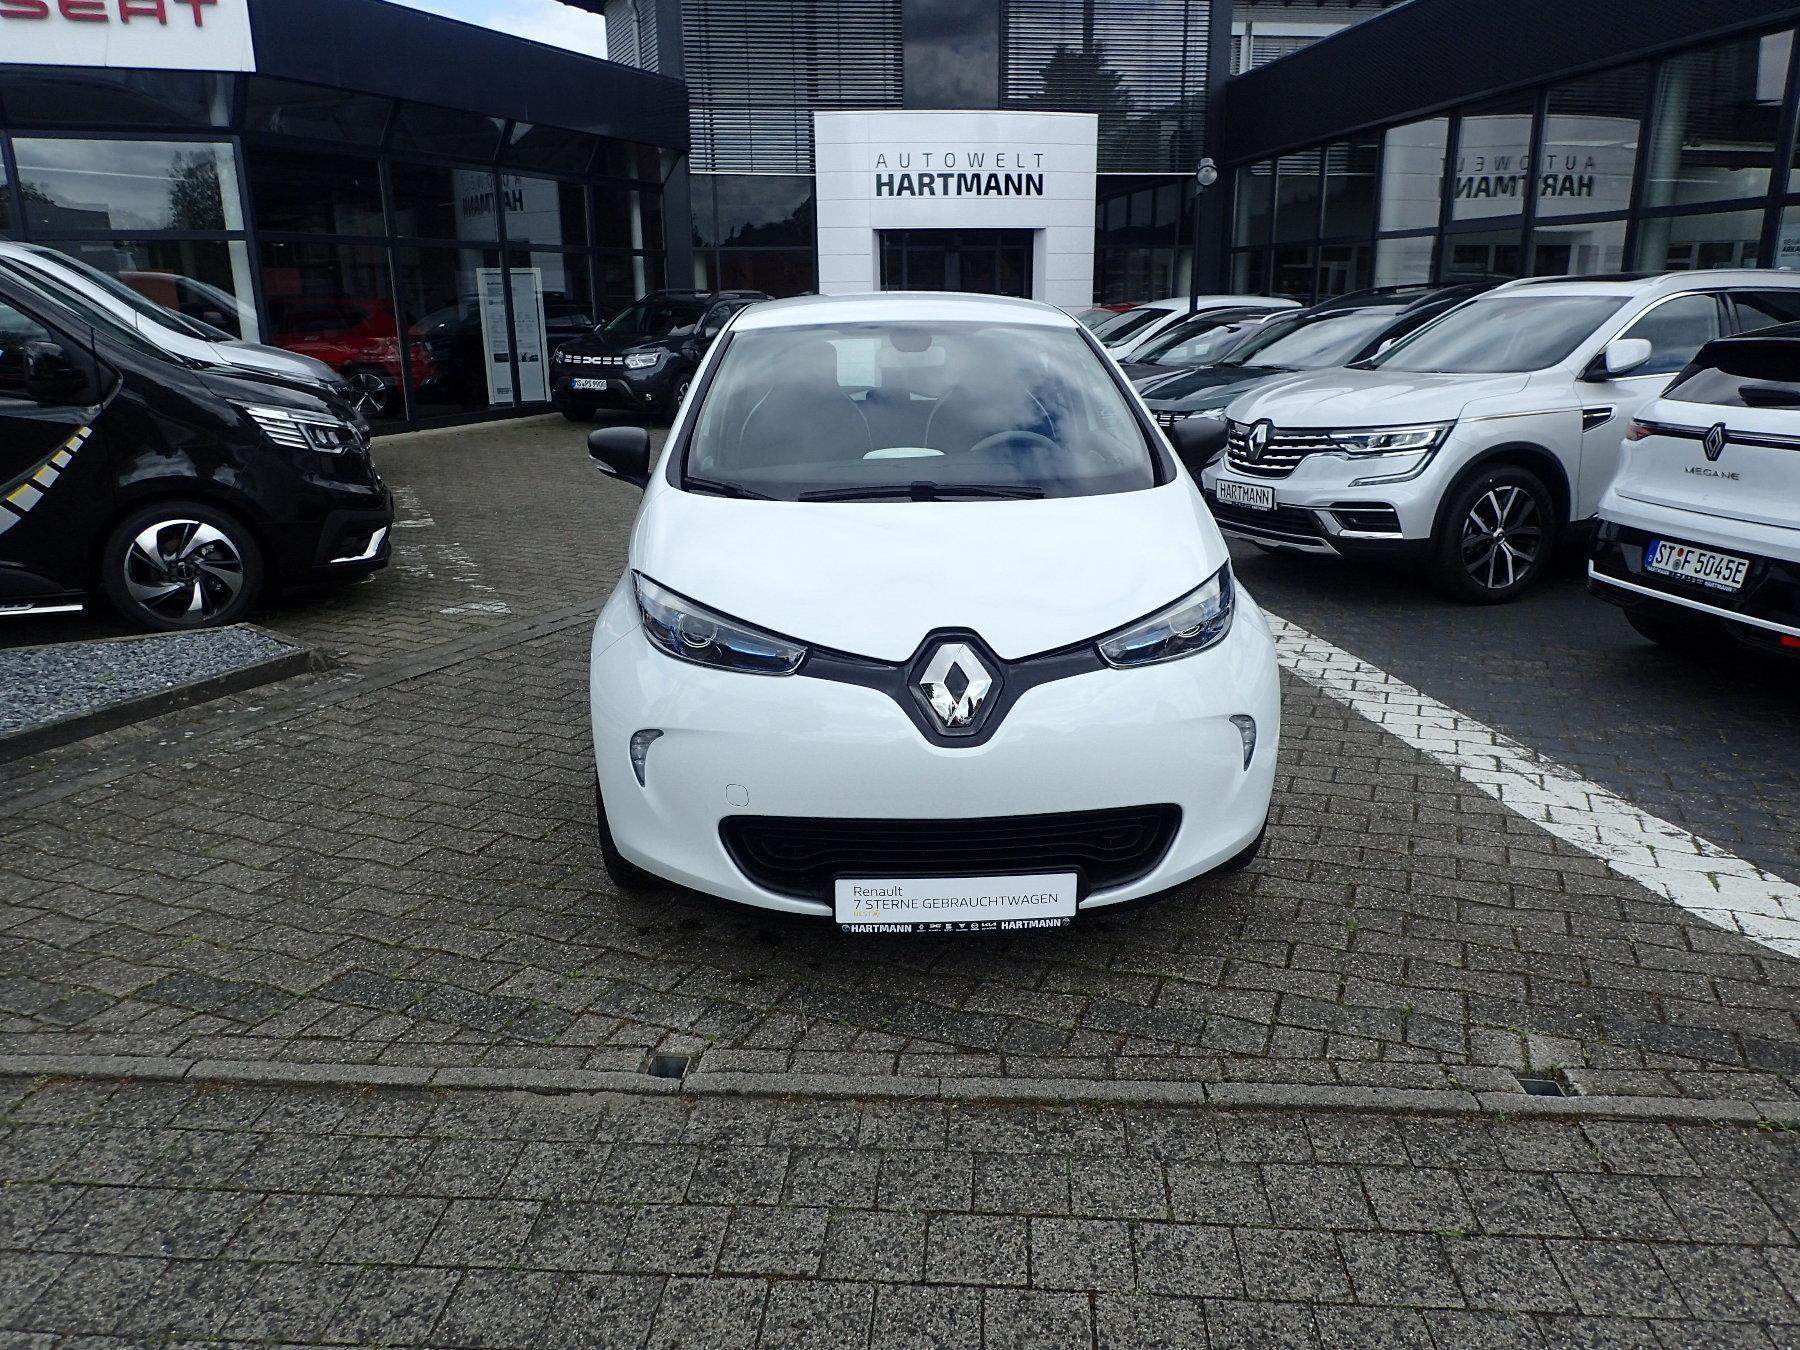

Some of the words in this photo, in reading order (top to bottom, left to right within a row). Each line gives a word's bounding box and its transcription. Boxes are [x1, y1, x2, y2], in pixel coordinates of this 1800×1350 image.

[0, 0, 218, 27] SEAT
[876, 152, 1044, 169] AUTOWELT
[876, 173, 1044, 197] HARTMANN
[1684, 466, 1741, 481] MEGANE
[1220, 482, 1270, 506] HARTMANN
[1655, 544, 1676, 566] ST
[1681, 549, 1695, 570] F
[1694, 552, 1747, 584] 5045E
[853, 885, 903, 897] Renault
[853, 900, 861, 910] 7
[865, 898, 920, 910] STERNE
[922, 893, 1058, 909] GEBRAUCHTWAGEN
[851, 924, 912, 933] HARTMANN
[1001, 919, 1061, 930] HARTMANN
